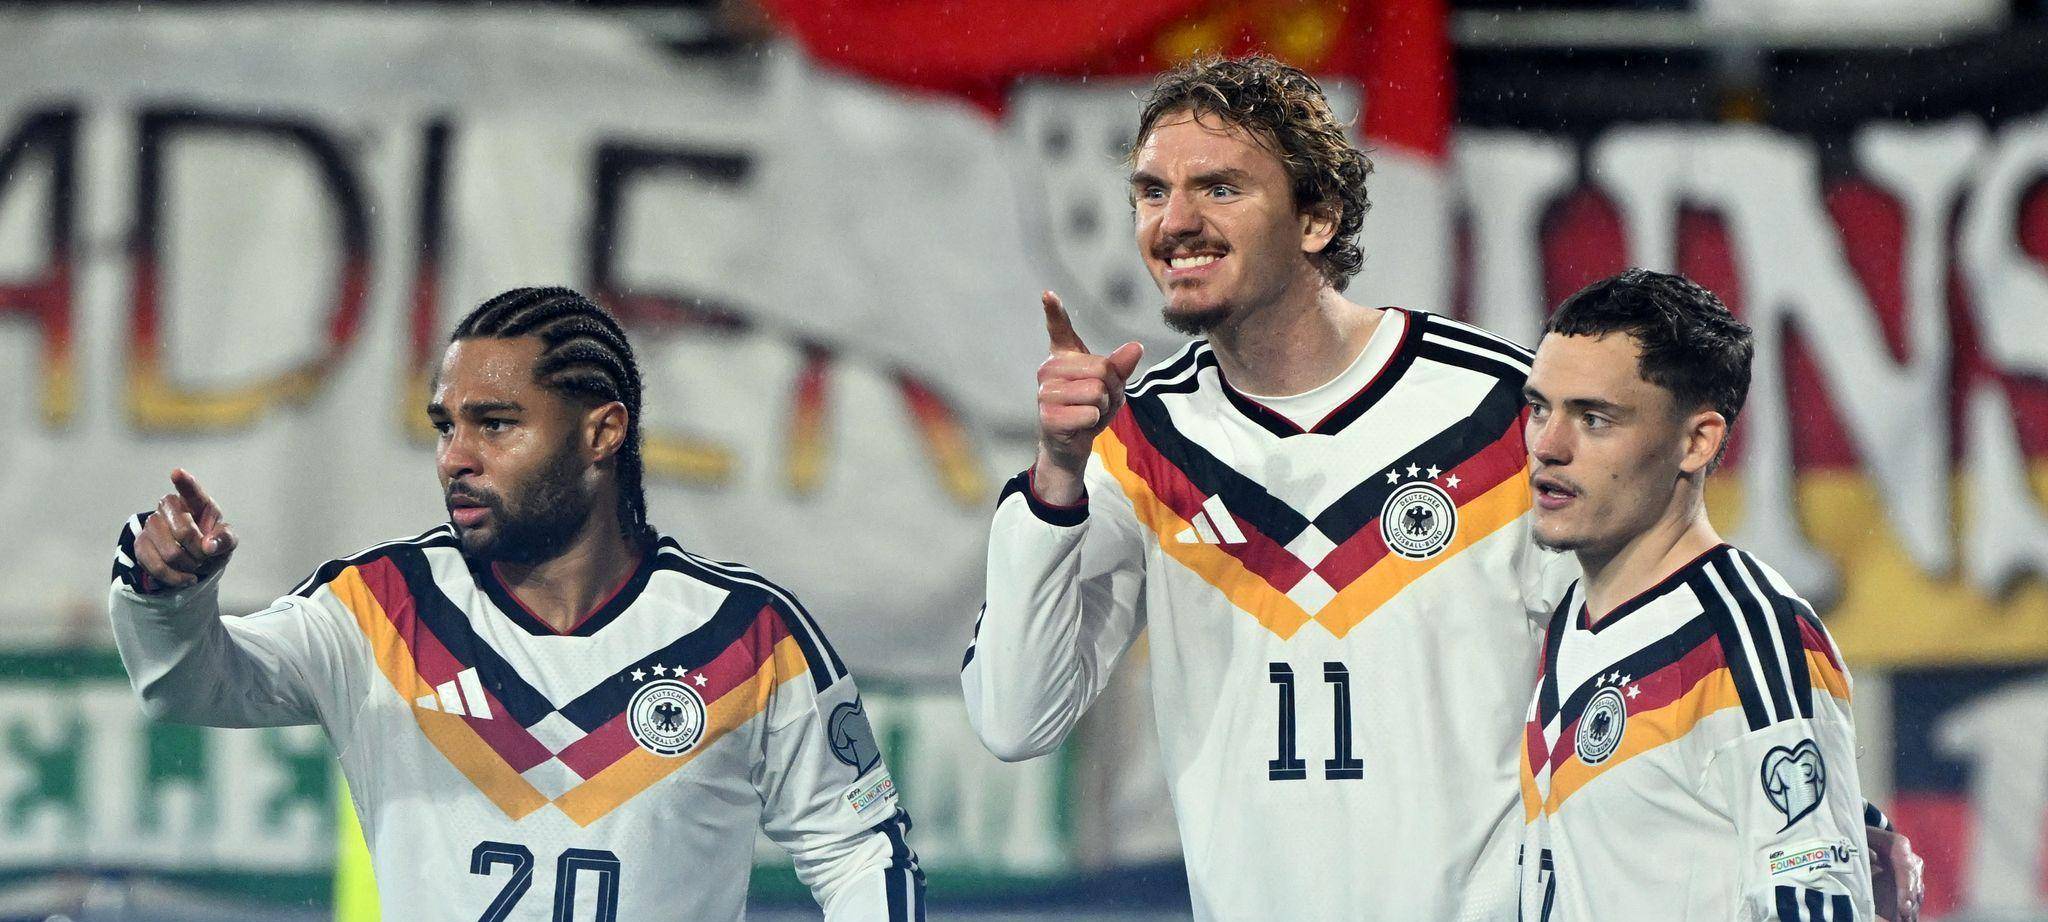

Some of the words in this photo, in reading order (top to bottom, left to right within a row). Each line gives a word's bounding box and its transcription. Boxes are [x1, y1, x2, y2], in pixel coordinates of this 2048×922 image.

[1400, 494, 1441, 509] DEUTSCHER
[1393, 527, 1443, 549] FUSSBALL-BUND
[647, 691, 690, 706] DEUTSCHER
[1268, 661, 1364, 781] 11
[642, 722, 693, 745] FUSSBALL-BUND
[852, 779, 892, 810] FOUNDATIO
[1770, 849, 1831, 872] FOUNDATION
[468, 840, 622, 922] 20
